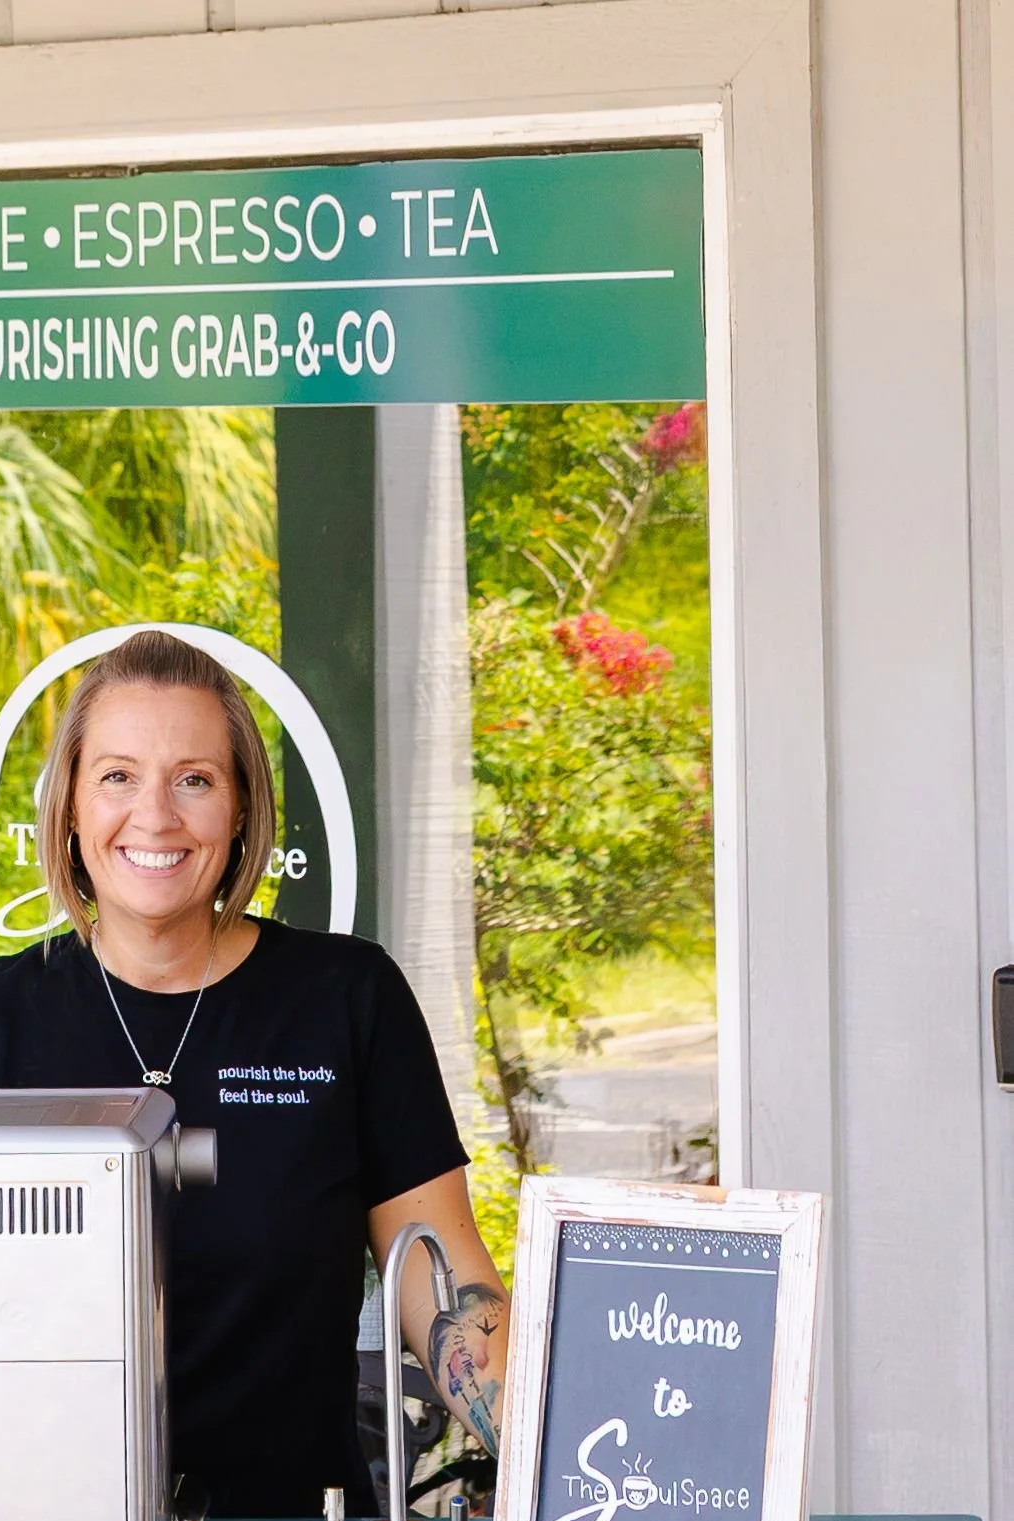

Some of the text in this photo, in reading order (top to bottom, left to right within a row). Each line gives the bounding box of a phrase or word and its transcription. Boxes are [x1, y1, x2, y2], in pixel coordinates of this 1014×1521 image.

[73, 194, 345, 269] ESPRESSO
[390, 188, 499, 258] TEA
[170, 309, 397, 379] GRAB-&-GO
[217, 1065, 336, 1083] nourish the body.
[219, 1088, 310, 1104] feed the soul.
[607, 1292, 742, 1350] welcome
[653, 1377, 693, 1418] to
[561, 1475, 607, 1503] The
